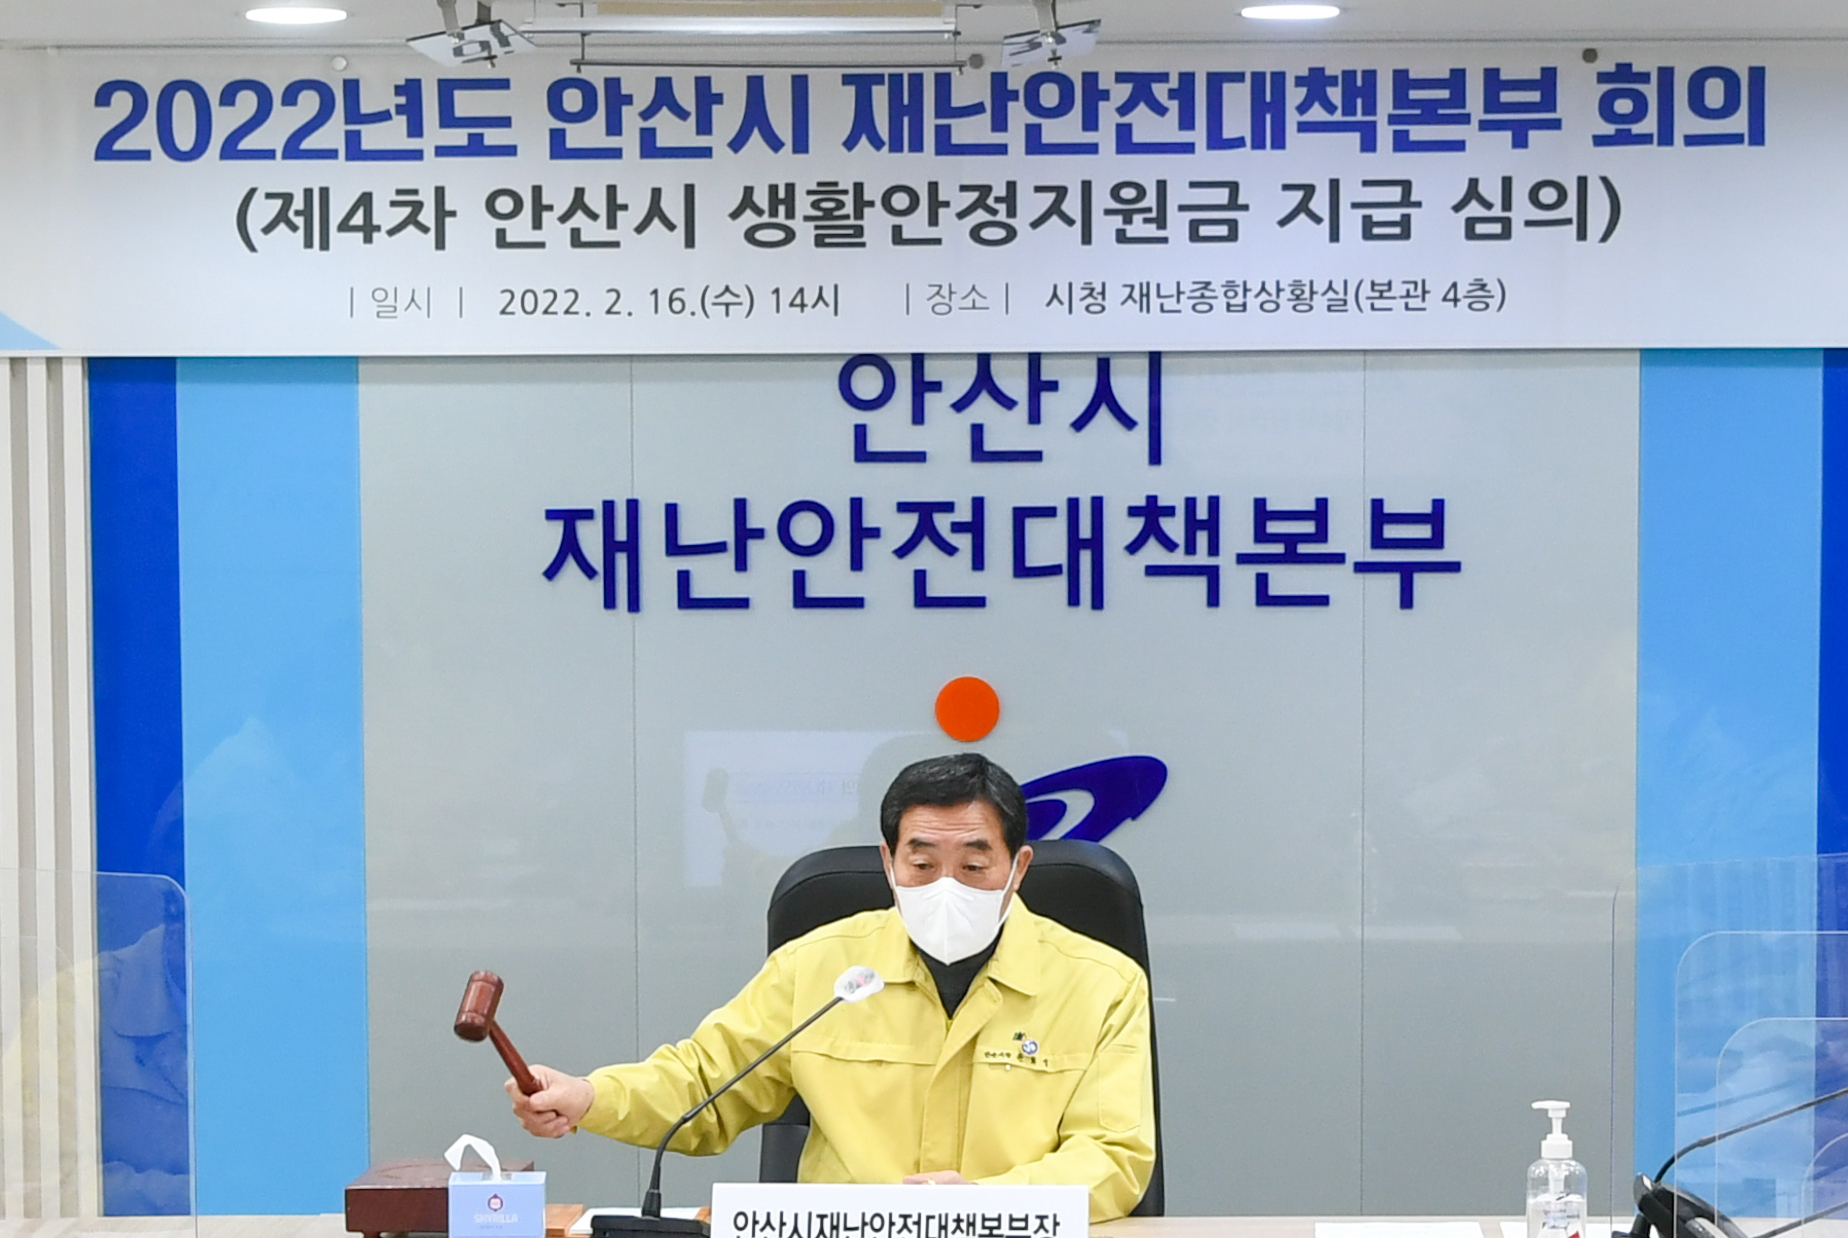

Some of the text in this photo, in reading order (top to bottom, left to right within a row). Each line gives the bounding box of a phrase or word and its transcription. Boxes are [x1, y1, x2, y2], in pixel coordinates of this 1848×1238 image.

[93, 60, 1767, 163] 2022년도 안산시 재난안전대책본부 회의
[235, 174, 1623, 253] (제4차 안산시 생활안정지원금 지급 심의)
[371, 282, 841, 320] 일시 2022. 2. 16.(수) 14시
[925, 277, 1508, 317] 장소 시청 재난종합상황실(본관 4층)
[837, 352, 1165, 467] 안산시
[541, 494, 1463, 614] 재난안전대책본부
